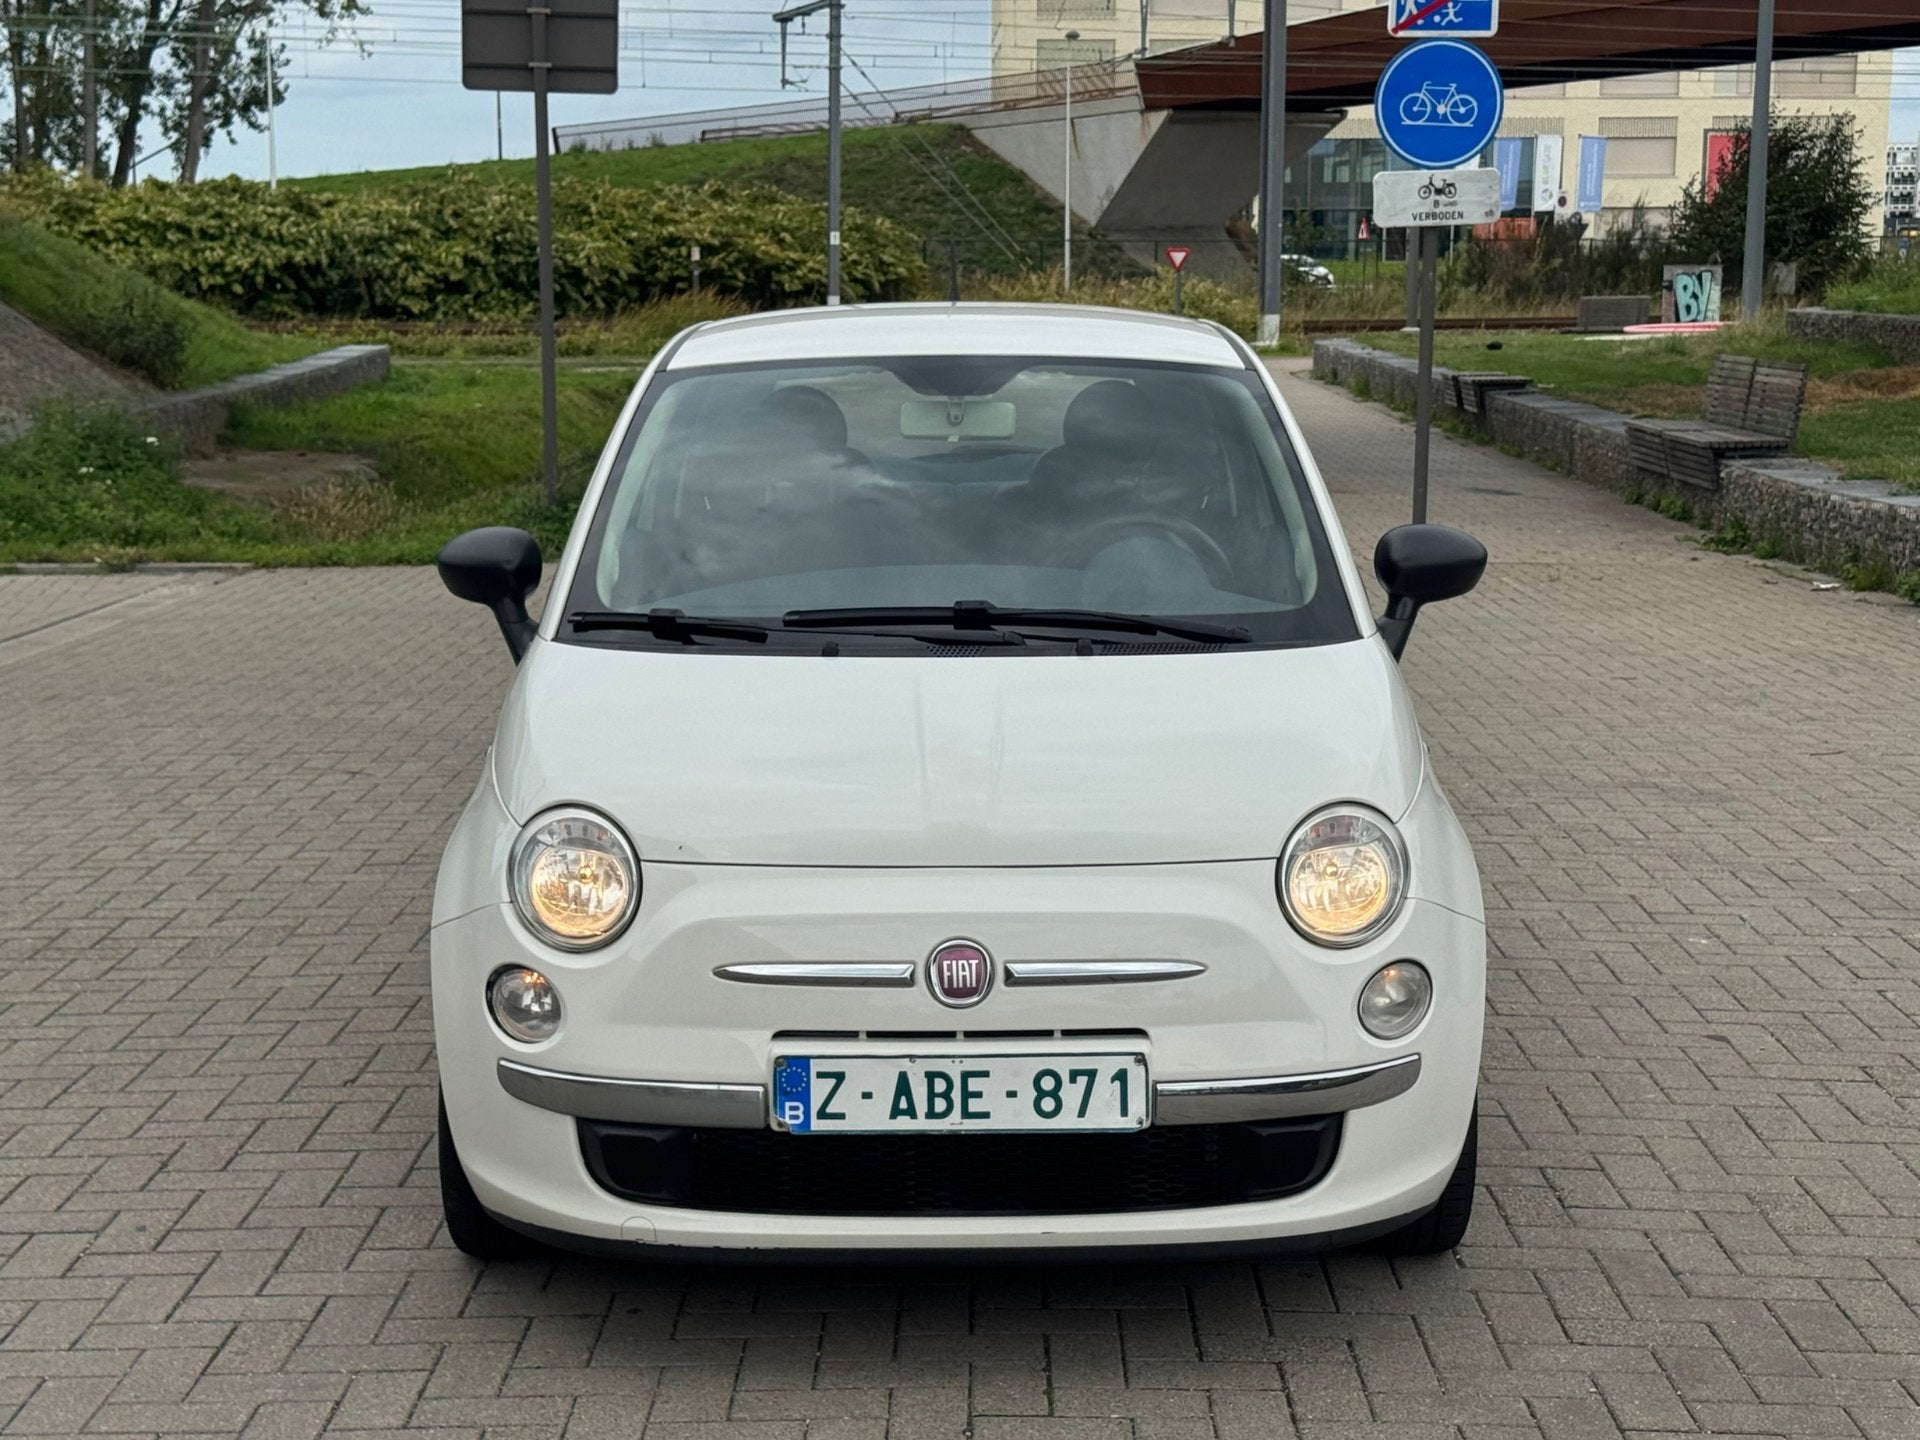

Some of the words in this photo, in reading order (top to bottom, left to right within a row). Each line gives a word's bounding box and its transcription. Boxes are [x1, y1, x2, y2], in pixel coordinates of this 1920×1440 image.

[1411, 211, 1464, 221] VERBODEN
[942, 960, 979, 989] FIAT
[785, 1101, 805, 1124] B
